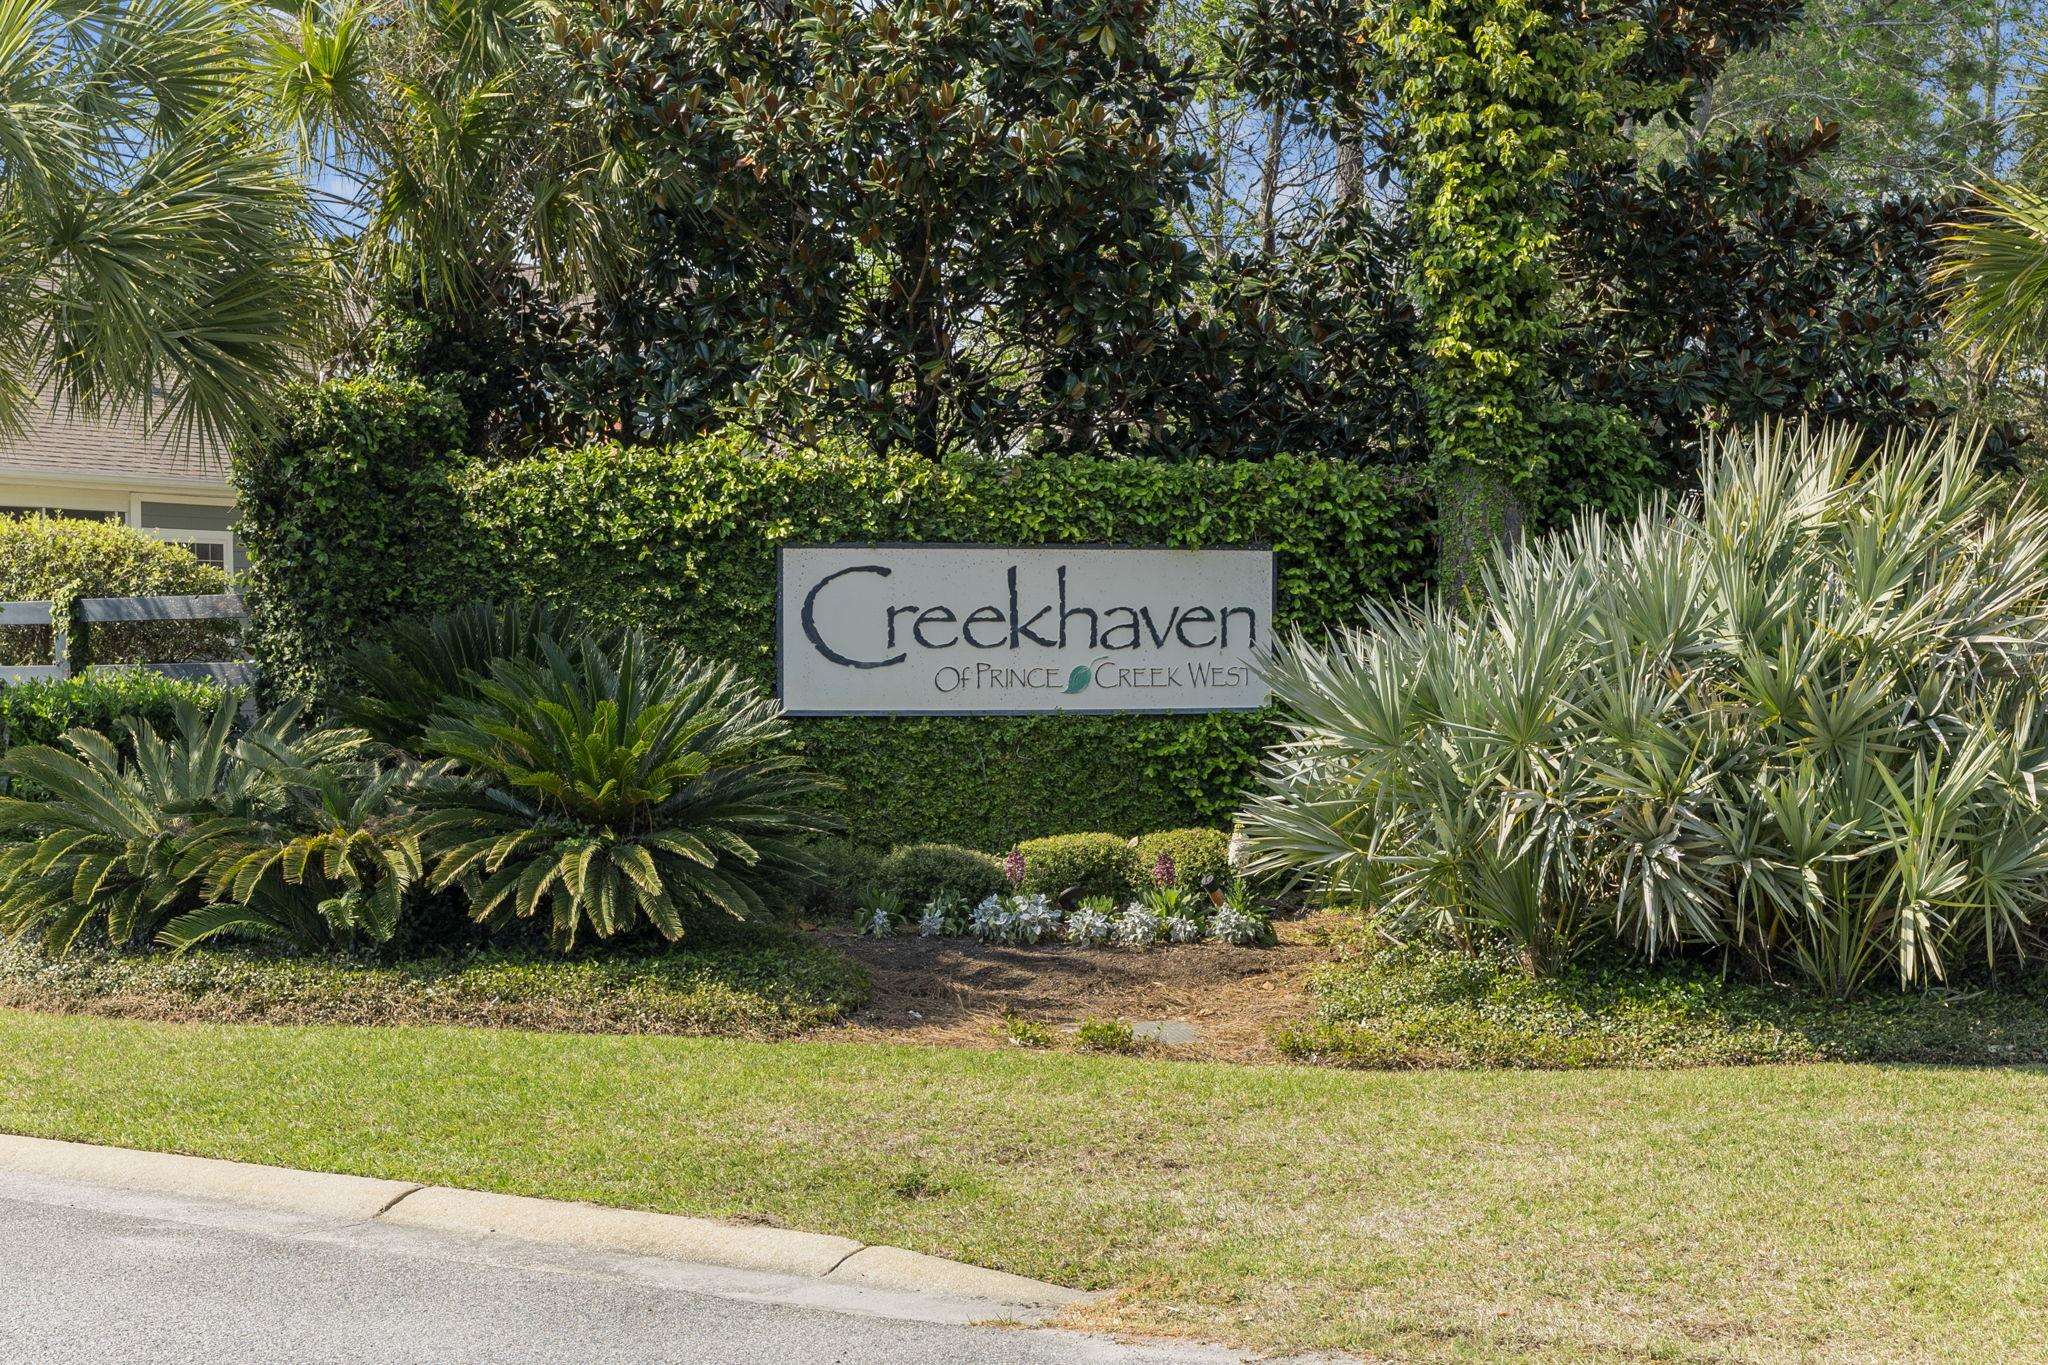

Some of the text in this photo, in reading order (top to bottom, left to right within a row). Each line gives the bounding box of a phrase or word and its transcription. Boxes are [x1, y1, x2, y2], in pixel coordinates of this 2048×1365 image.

[801, 564, 1257, 669] Creekhaven
[934, 661, 1250, 692] Of PRINCE CREEK WEST
